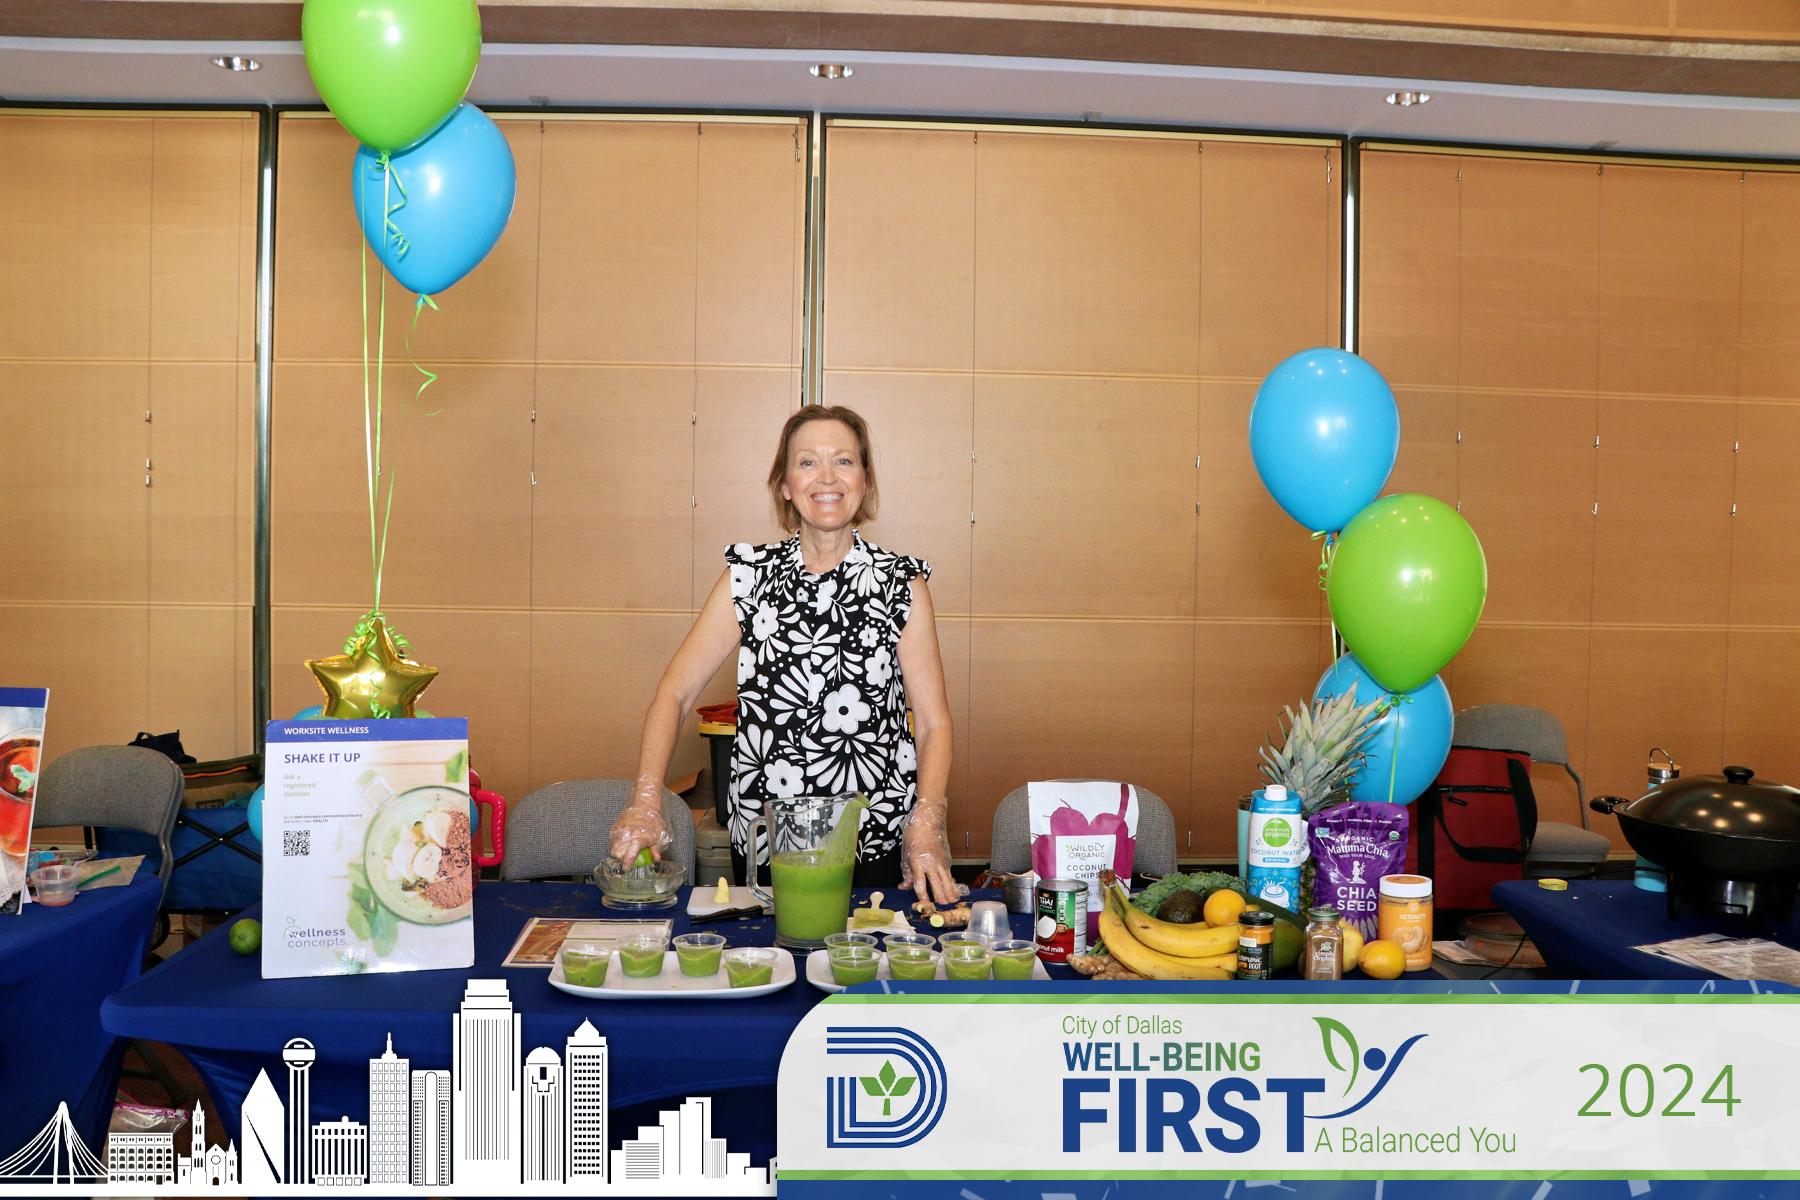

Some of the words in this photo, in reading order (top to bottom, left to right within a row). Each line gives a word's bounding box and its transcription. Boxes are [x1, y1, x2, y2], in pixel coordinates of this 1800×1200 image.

[284, 727, 326, 735] WORKSITE
[327, 726, 369, 734] WELLNESS
[284, 753, 325, 764] SHAKE
[329, 753, 340, 763] IT
[344, 752, 361, 763] UP
[1264, 831, 1290, 839] organic
[1072, 842, 1105, 852] WILDLY
[1068, 852, 1105, 860] ORGANIC
[1067, 863, 1107, 871] COCONUT
[1336, 886, 1377, 899] CHIA
[1039, 897, 1054, 906] THAI
[1336, 900, 1377, 911] SEED
[287, 937, 346, 949] concepts
